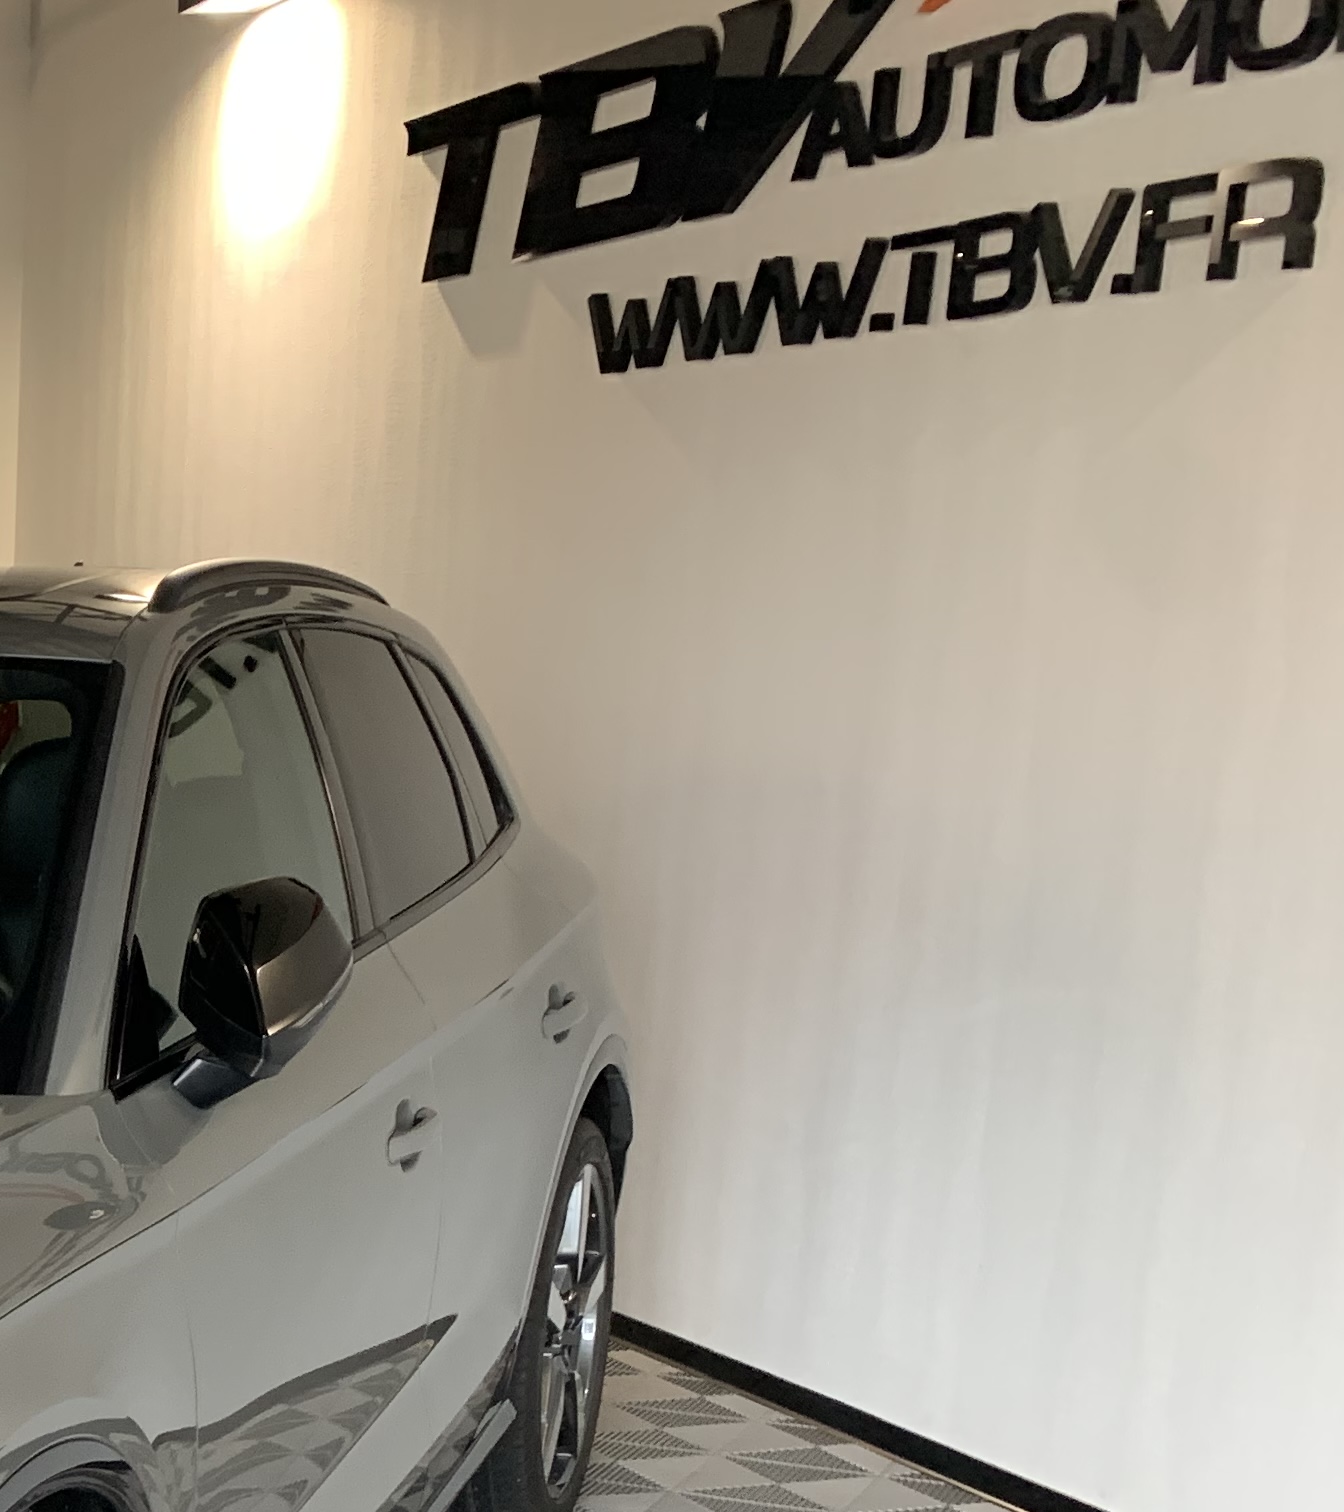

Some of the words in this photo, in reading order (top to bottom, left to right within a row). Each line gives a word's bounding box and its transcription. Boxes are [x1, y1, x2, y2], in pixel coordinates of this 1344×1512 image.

[403, 0, 894, 282] TBV
[791, 0, 1344, 182] AUTOMO
[588, 157, 1325, 374] WWW.TBV.FR
